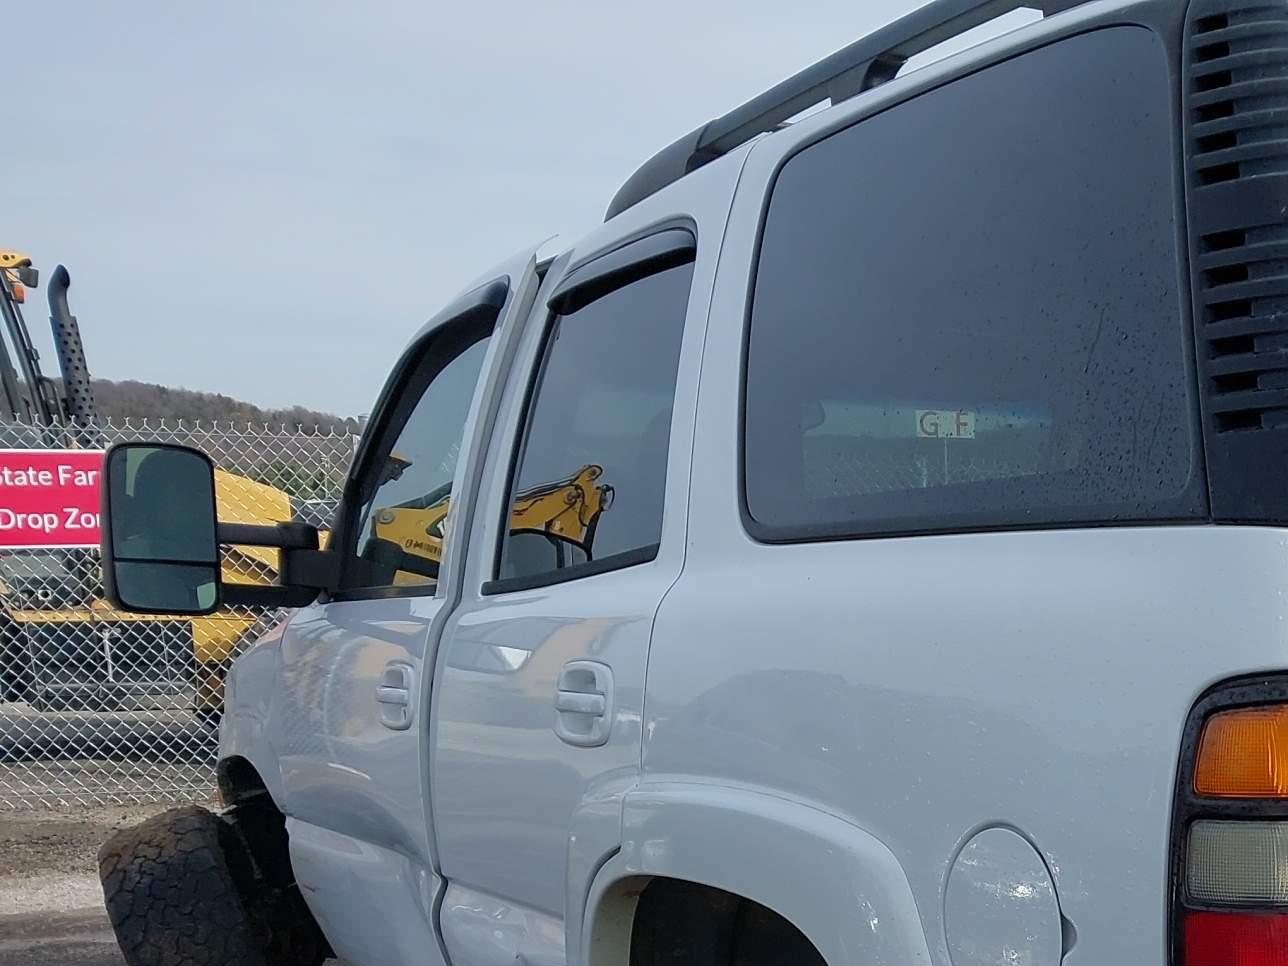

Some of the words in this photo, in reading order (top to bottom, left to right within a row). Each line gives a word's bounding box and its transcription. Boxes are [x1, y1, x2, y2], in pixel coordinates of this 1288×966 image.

[0, 466, 53, 486] tate
[57, 465, 100, 486] Far
[0, 508, 59, 533] Drop
